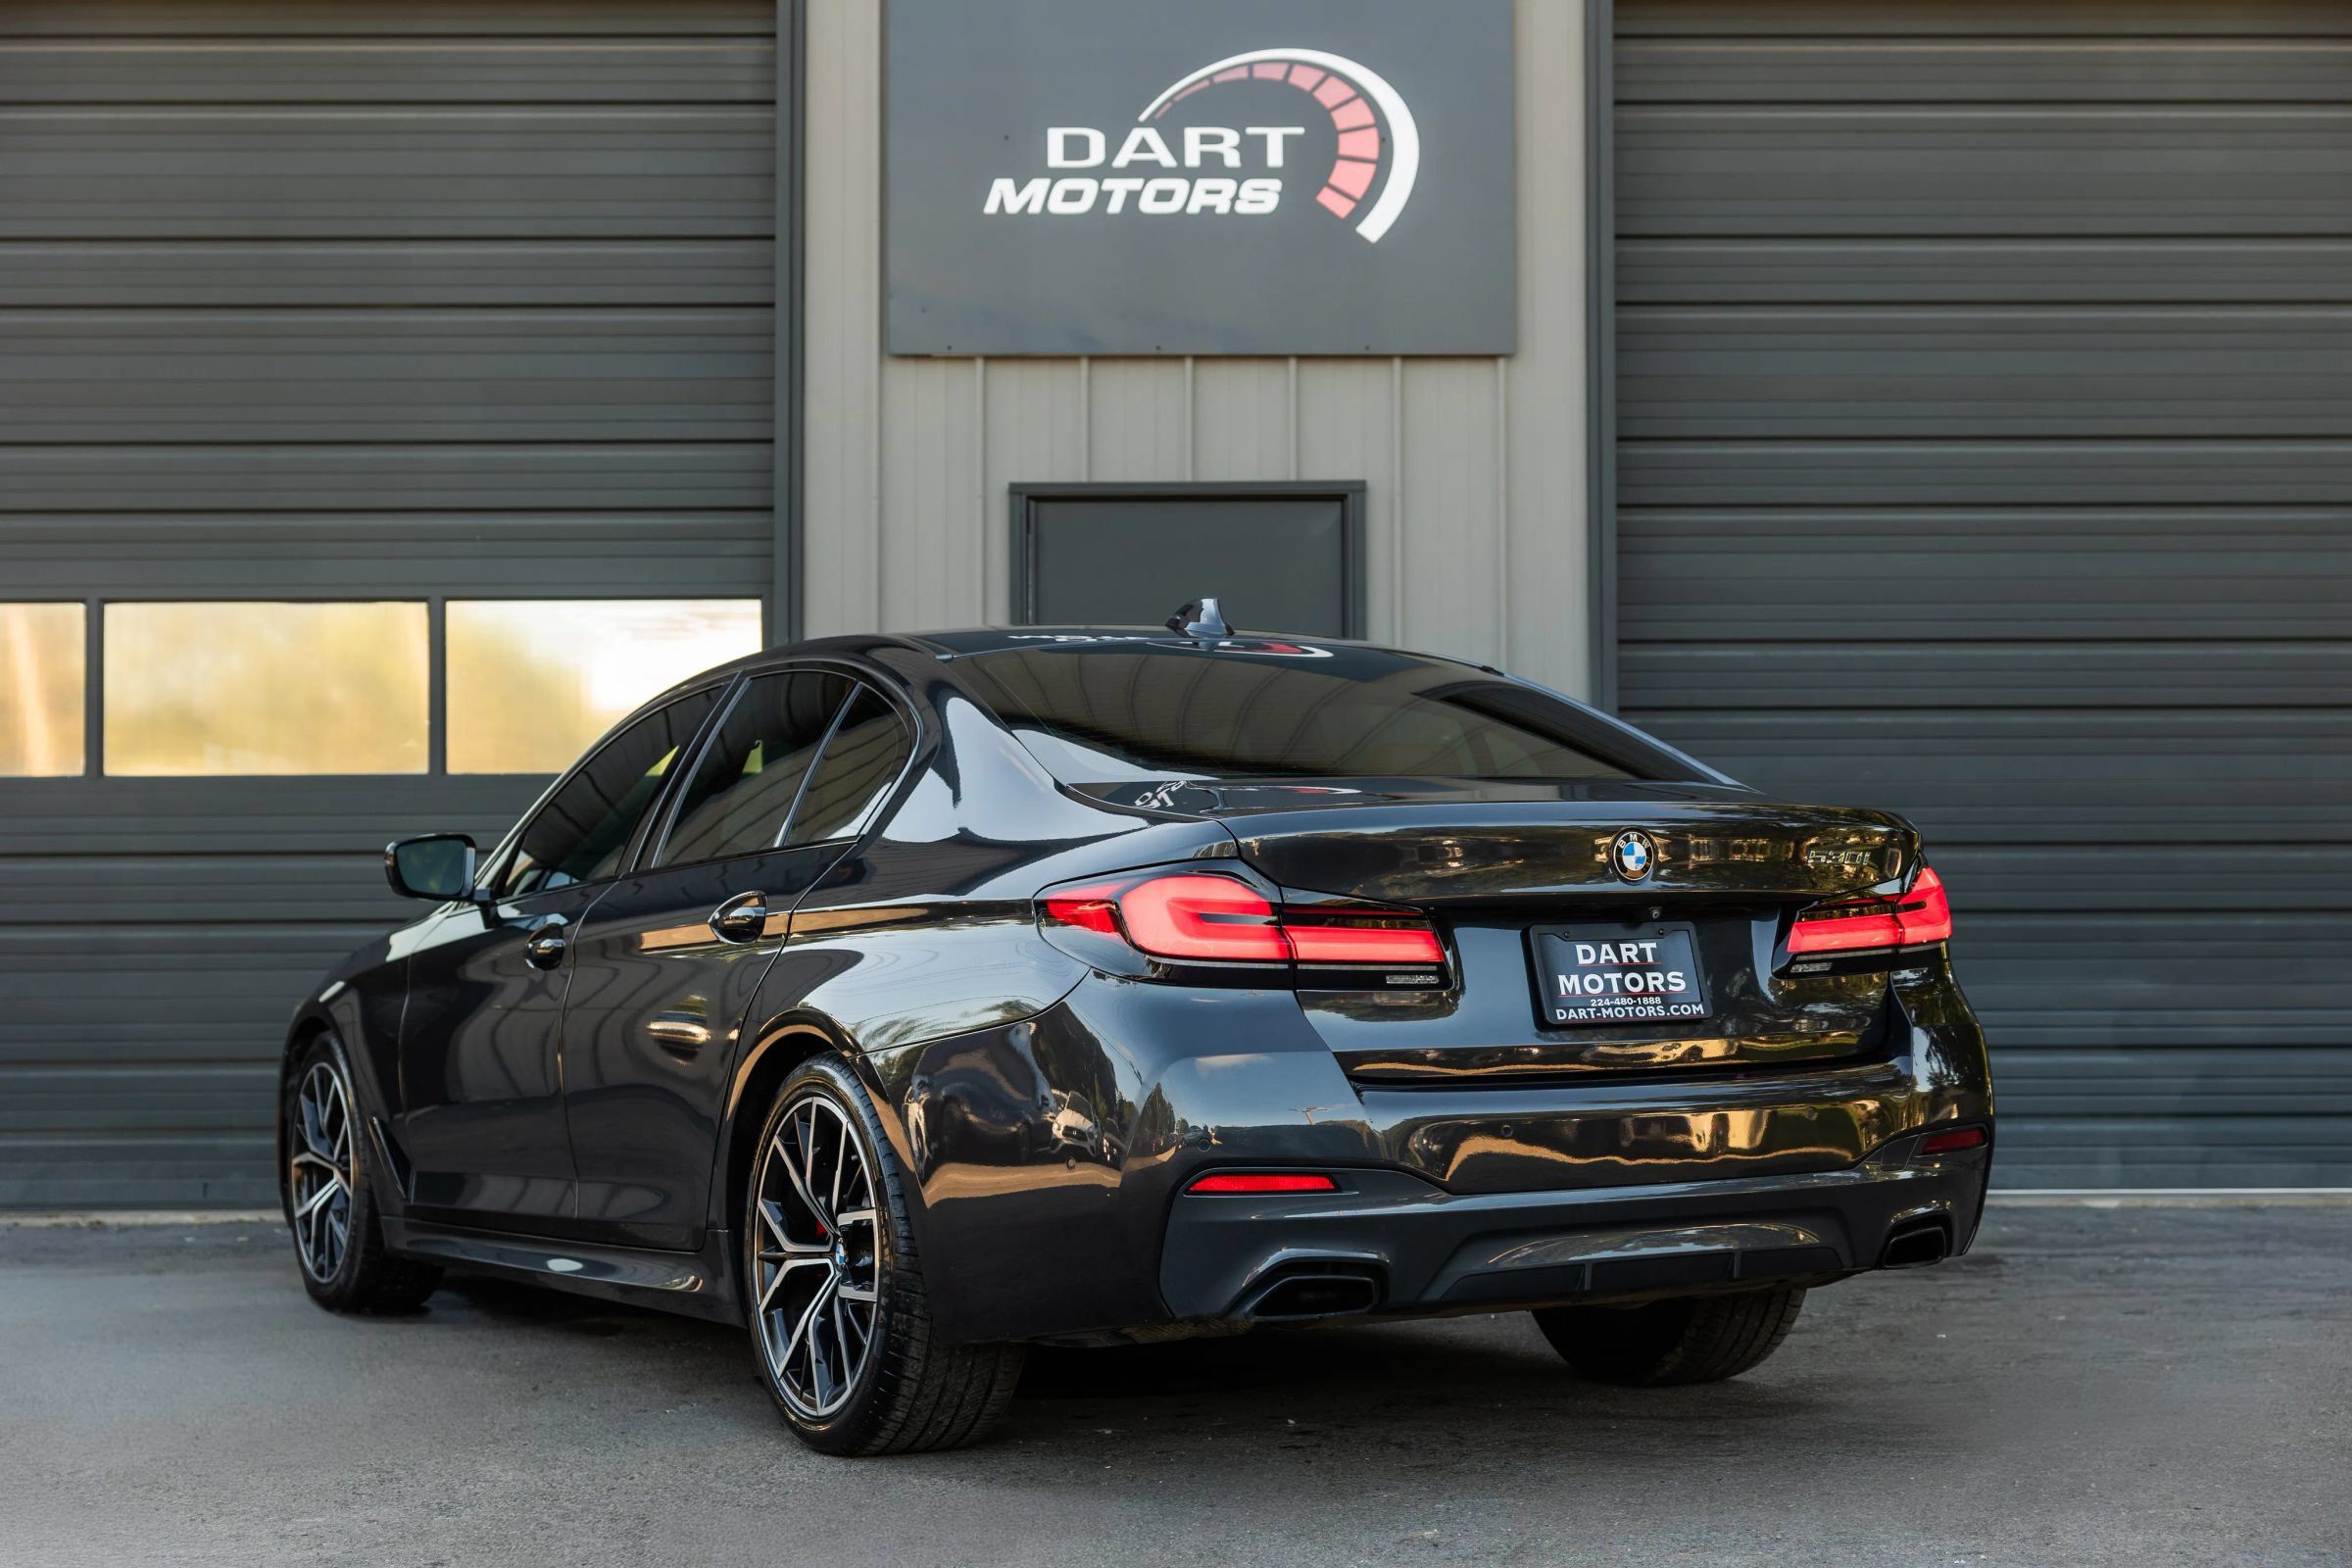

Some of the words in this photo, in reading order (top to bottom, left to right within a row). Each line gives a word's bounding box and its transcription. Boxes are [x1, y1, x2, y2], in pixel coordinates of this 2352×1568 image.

[1047, 126, 1305, 169] DART
[983, 177, 1283, 216] MOTORS
[1617, 833, 1650, 850] BMW
[1575, 942, 1657, 964] DART
[1558, 971, 1687, 996] MOTORS
[1556, 1004, 1704, 1020] DART-MOTORS.COM
[1591, 997, 1662, 1006] 224-480-1888
